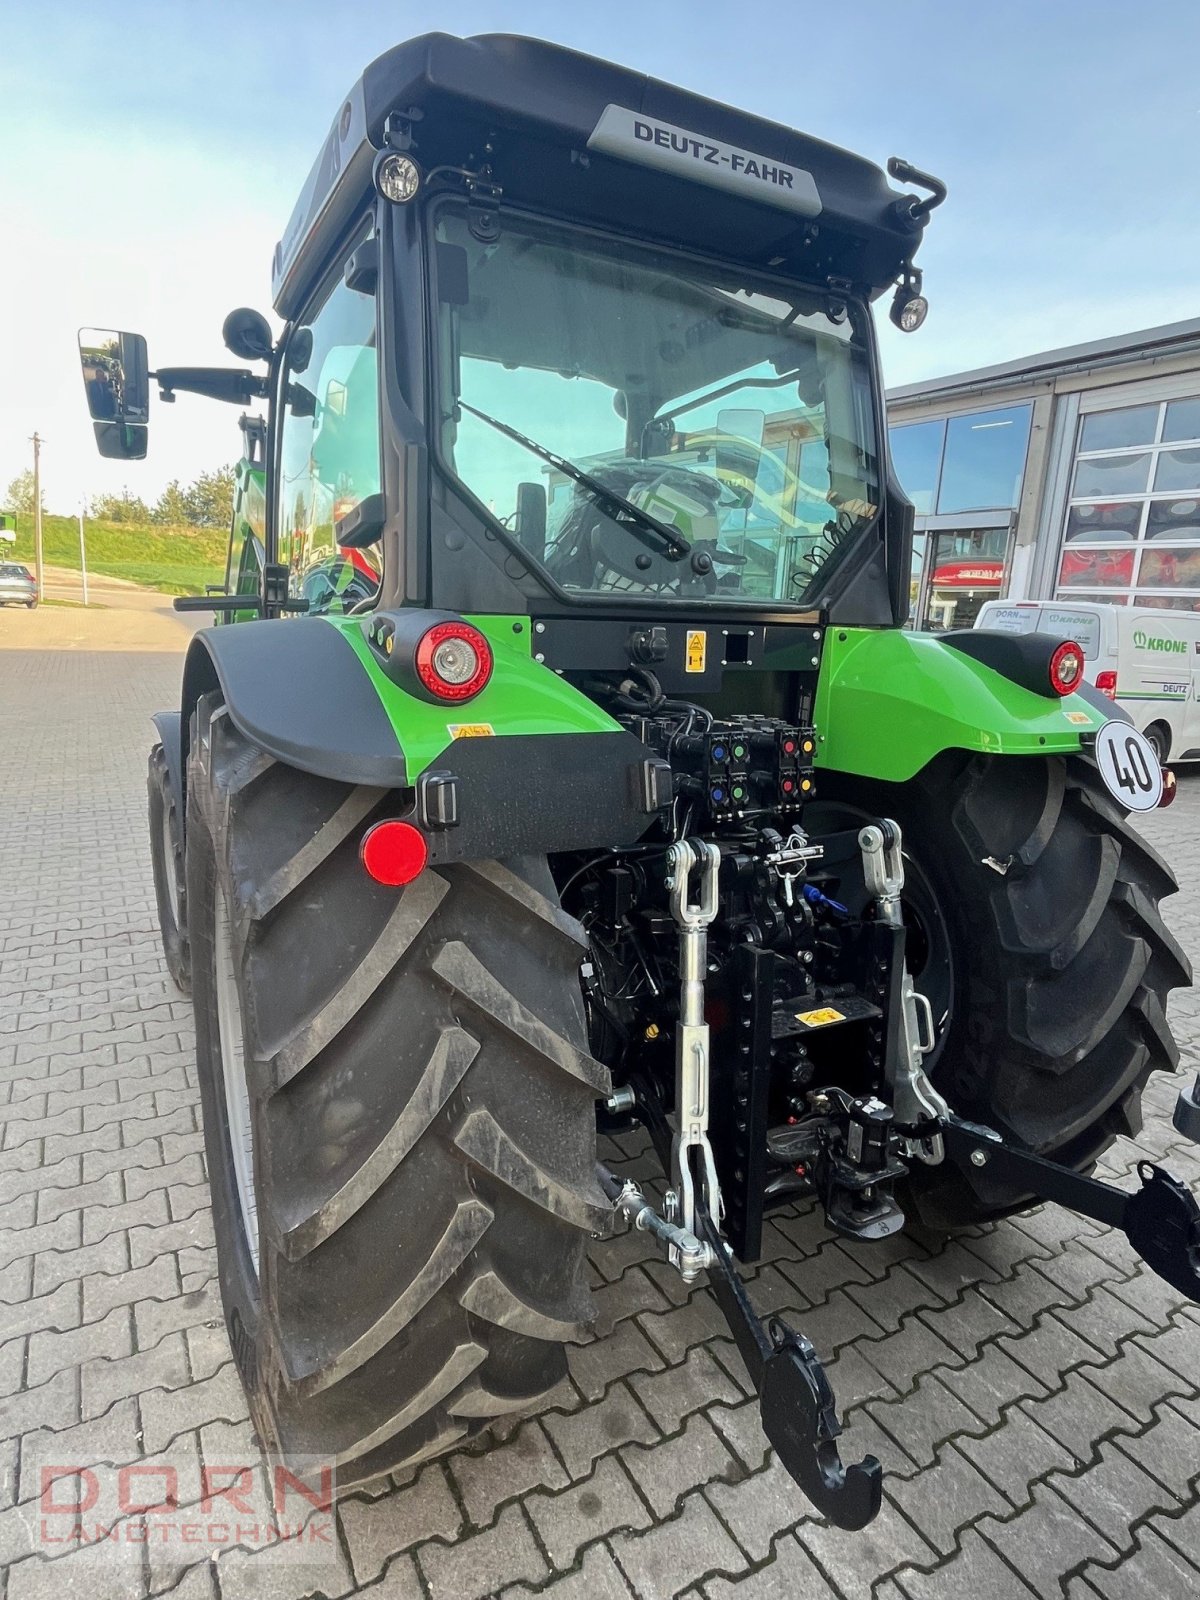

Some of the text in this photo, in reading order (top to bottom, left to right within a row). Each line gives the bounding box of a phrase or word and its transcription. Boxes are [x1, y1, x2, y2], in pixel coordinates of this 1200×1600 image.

[633, 120, 794, 189] DEUTZ-FAHR
[996, 610, 1019, 618] DORN
[1148, 637, 1187, 653] KRONE
[1163, 684, 1187, 693] DEUTZ
[1108, 736, 1153, 795] 40
